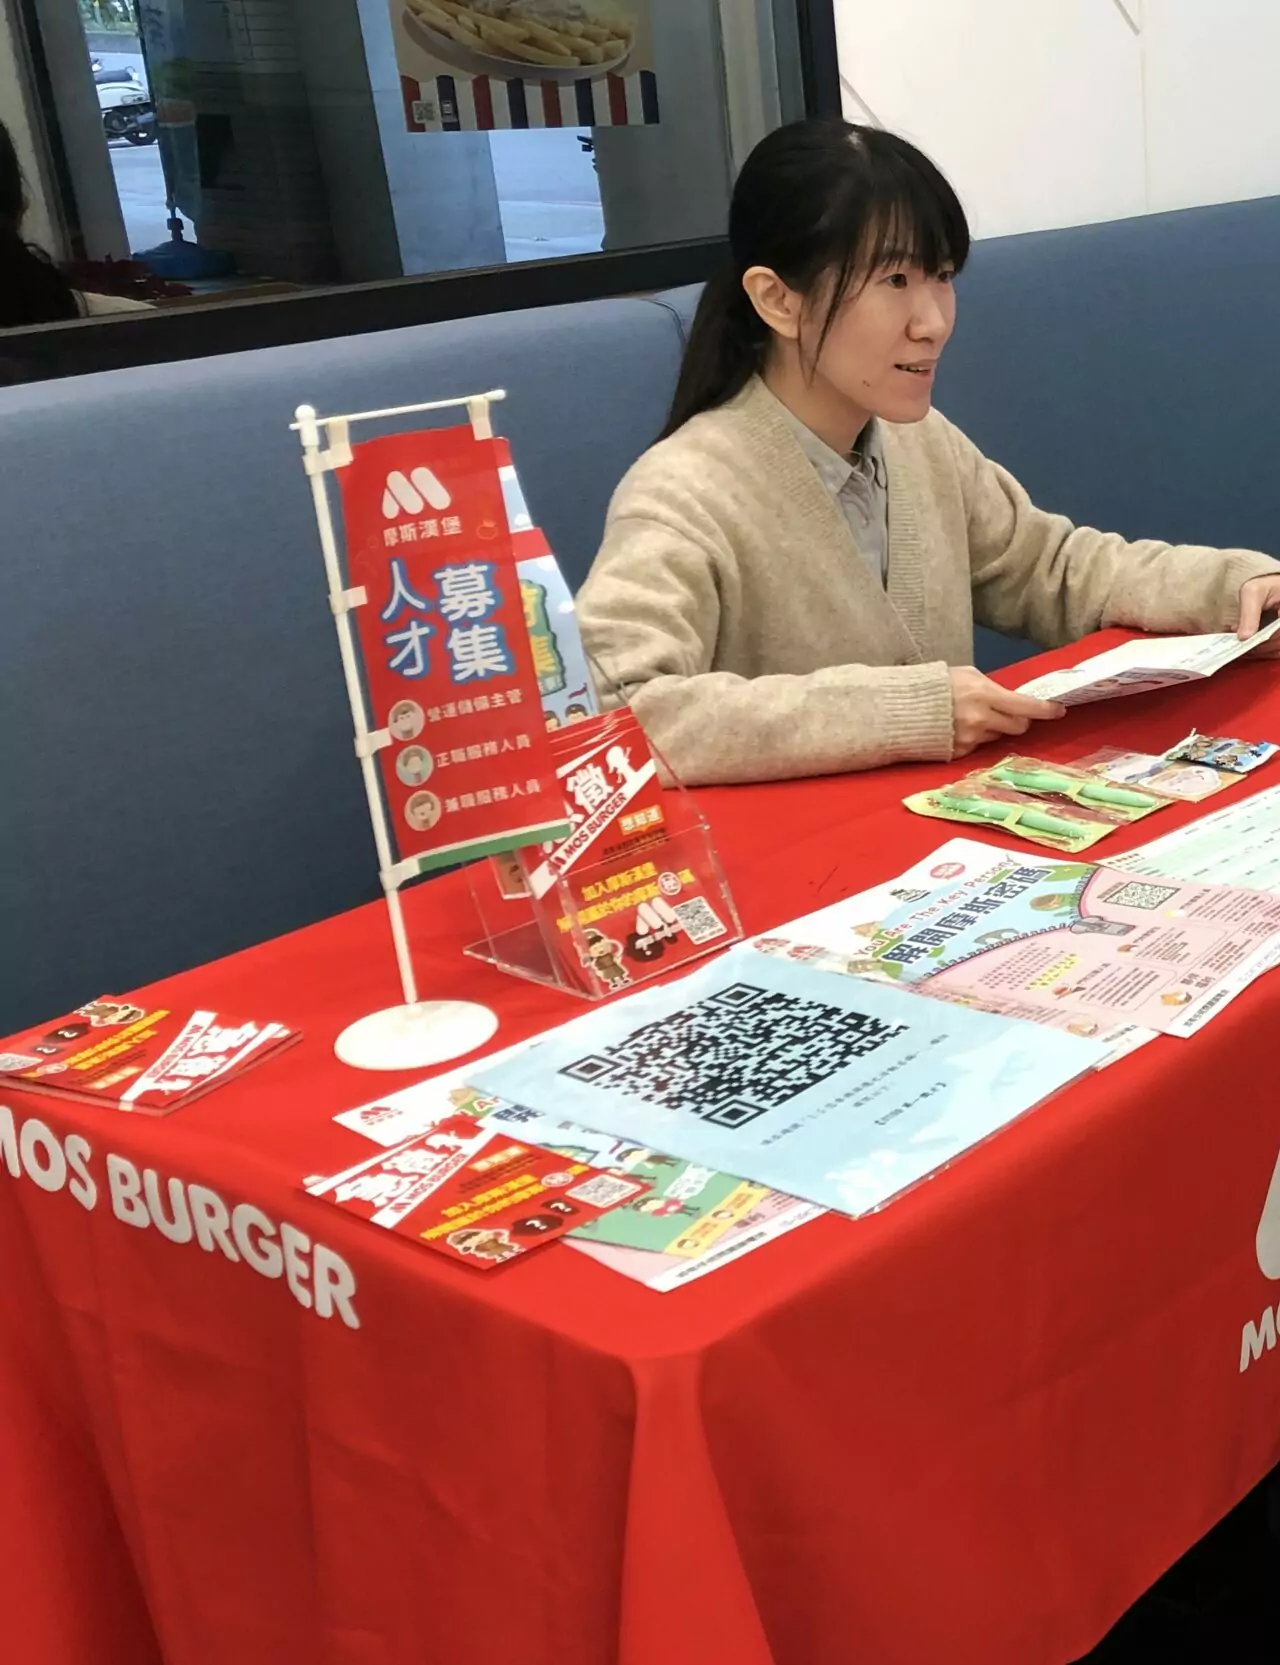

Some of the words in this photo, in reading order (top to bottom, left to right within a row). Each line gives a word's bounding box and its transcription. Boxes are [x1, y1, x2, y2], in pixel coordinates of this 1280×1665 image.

[383, 515, 463, 548] 摩斯漢堡
[436, 734, 531, 768] 正職服務人員
[445, 778, 541, 813] 兼職服務人員
[563, 829, 590, 864] MOS
[585, 791, 628, 840] BURGER
[853, 937, 886, 957] You
[884, 920, 913, 940] Are
[910, 904, 941, 924] The
[939, 887, 969, 908] Key
[881, 865, 1053, 964] 解開摩斯密碼
[106, 1152, 361, 1330] BURGER
